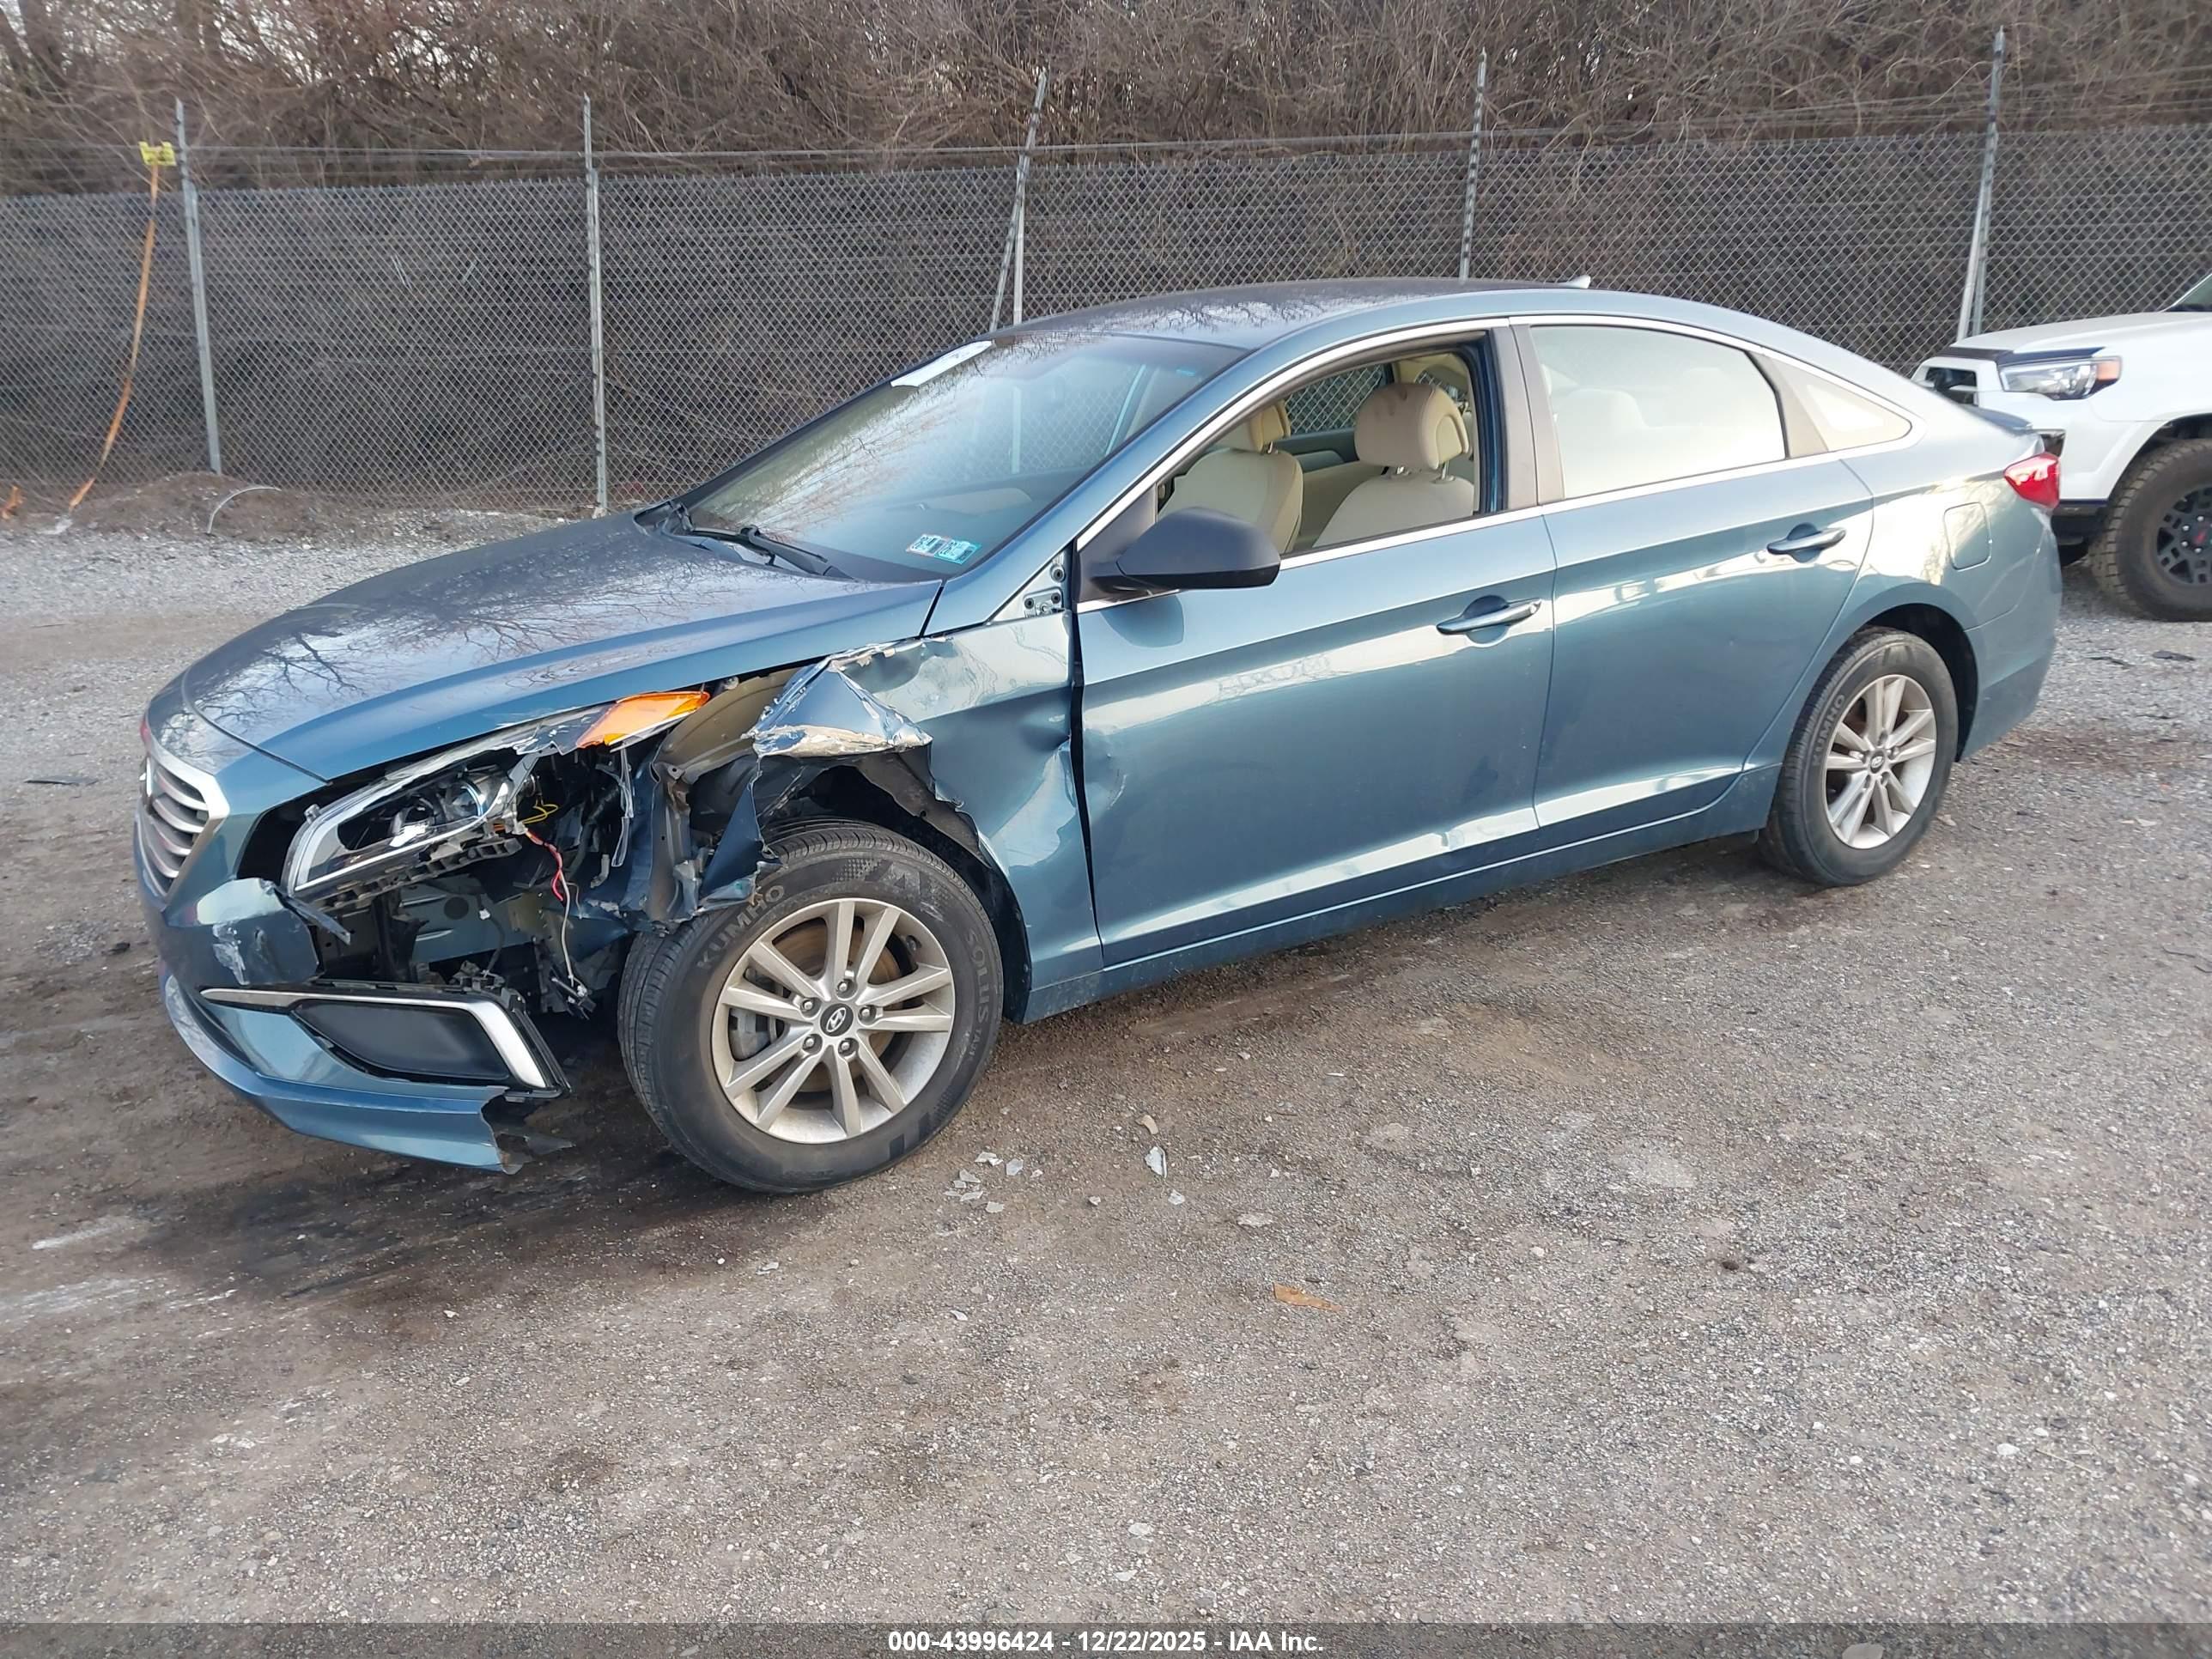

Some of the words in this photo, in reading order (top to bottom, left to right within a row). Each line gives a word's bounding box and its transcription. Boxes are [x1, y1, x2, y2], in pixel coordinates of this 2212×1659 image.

[1812, 694, 1845, 766] KUMHO
[696, 884, 785, 969] KUMHO
[964, 929, 989, 1024] SOLUS
